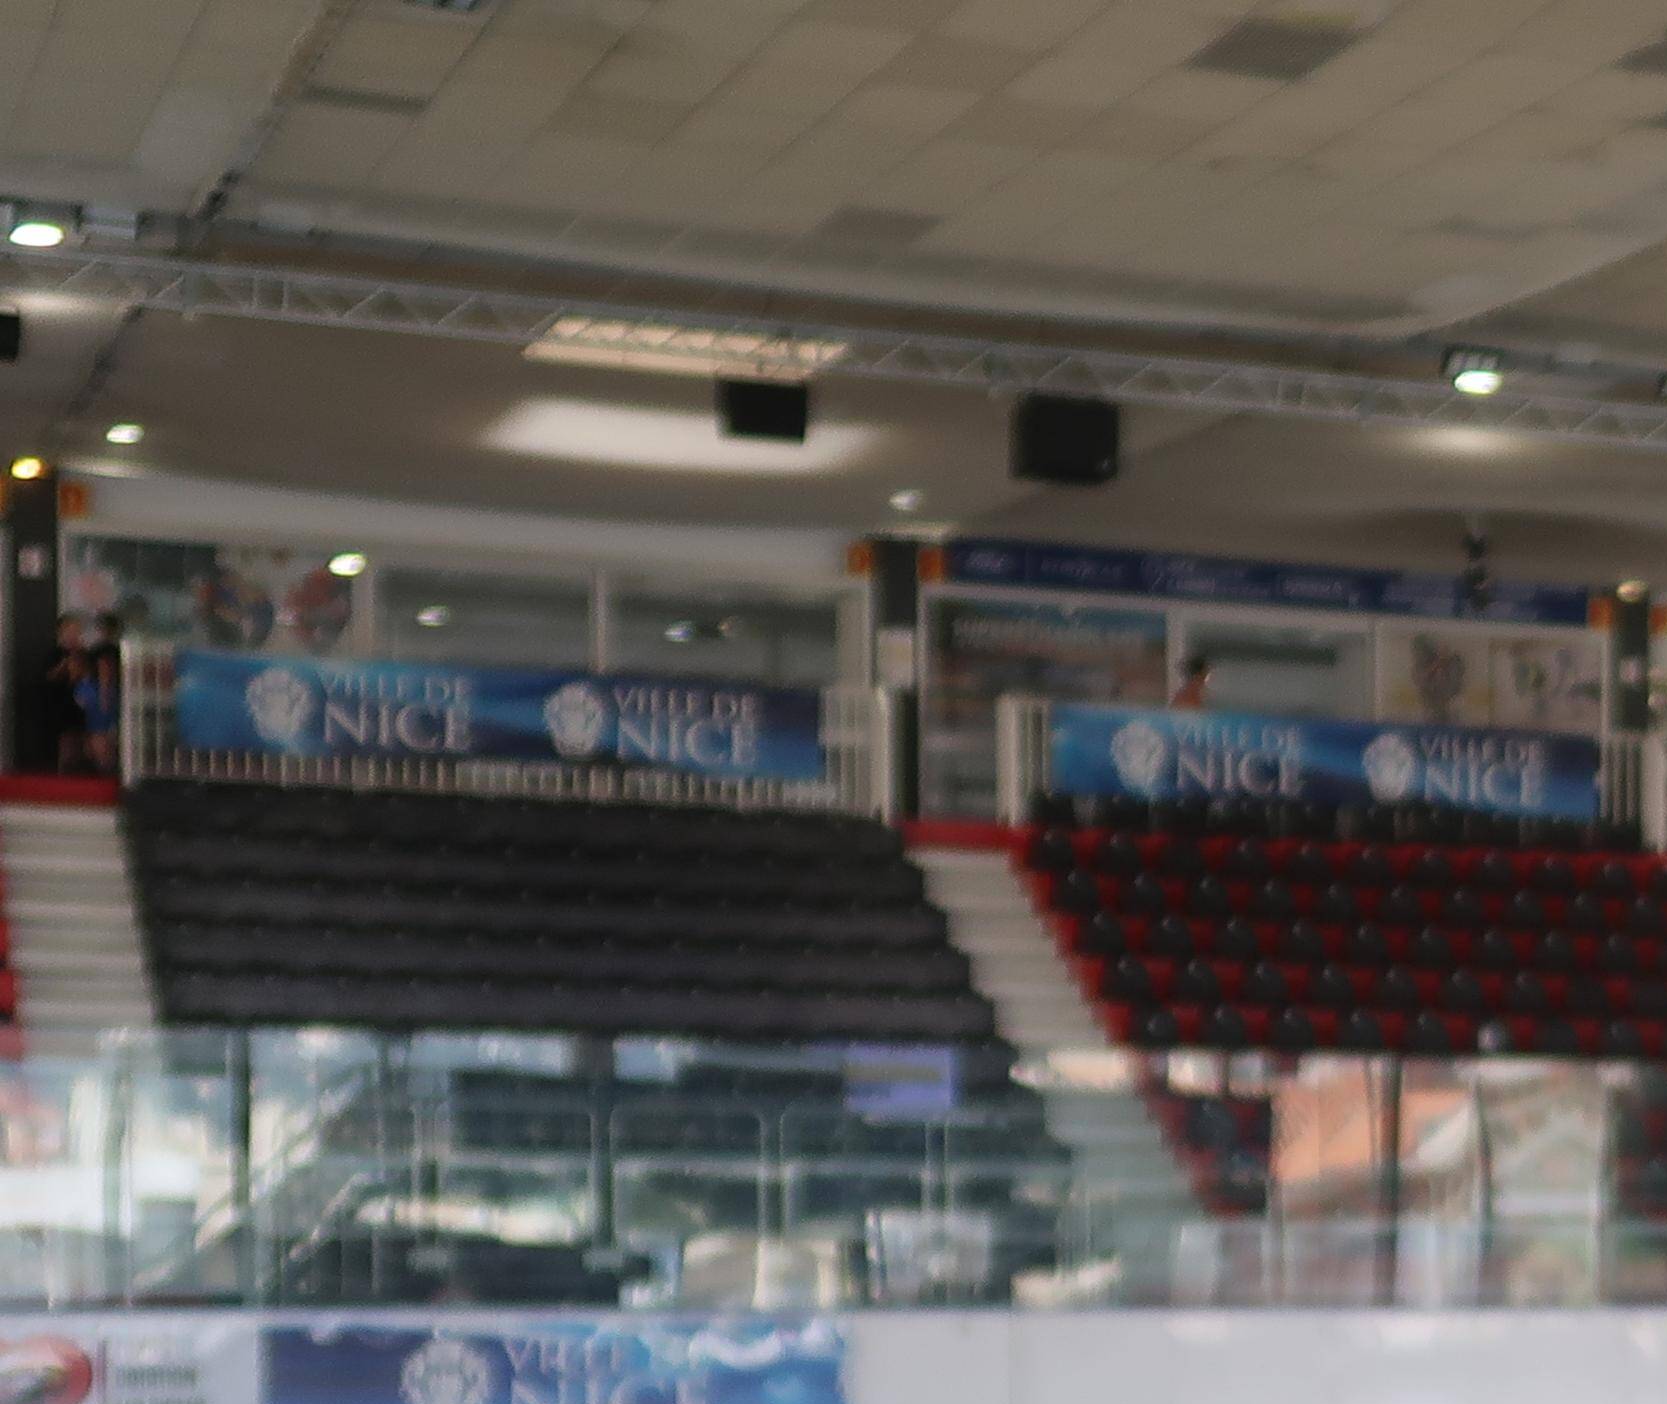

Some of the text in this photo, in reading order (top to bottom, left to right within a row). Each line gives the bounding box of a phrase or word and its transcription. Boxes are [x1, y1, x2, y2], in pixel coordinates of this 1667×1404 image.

[613, 686, 701, 716] VILLE
[323, 701, 472, 753] NICE
[616, 717, 758, 766] NICE
[1176, 748, 1302, 796] NICE
[1424, 762, 1543, 808] NICE
